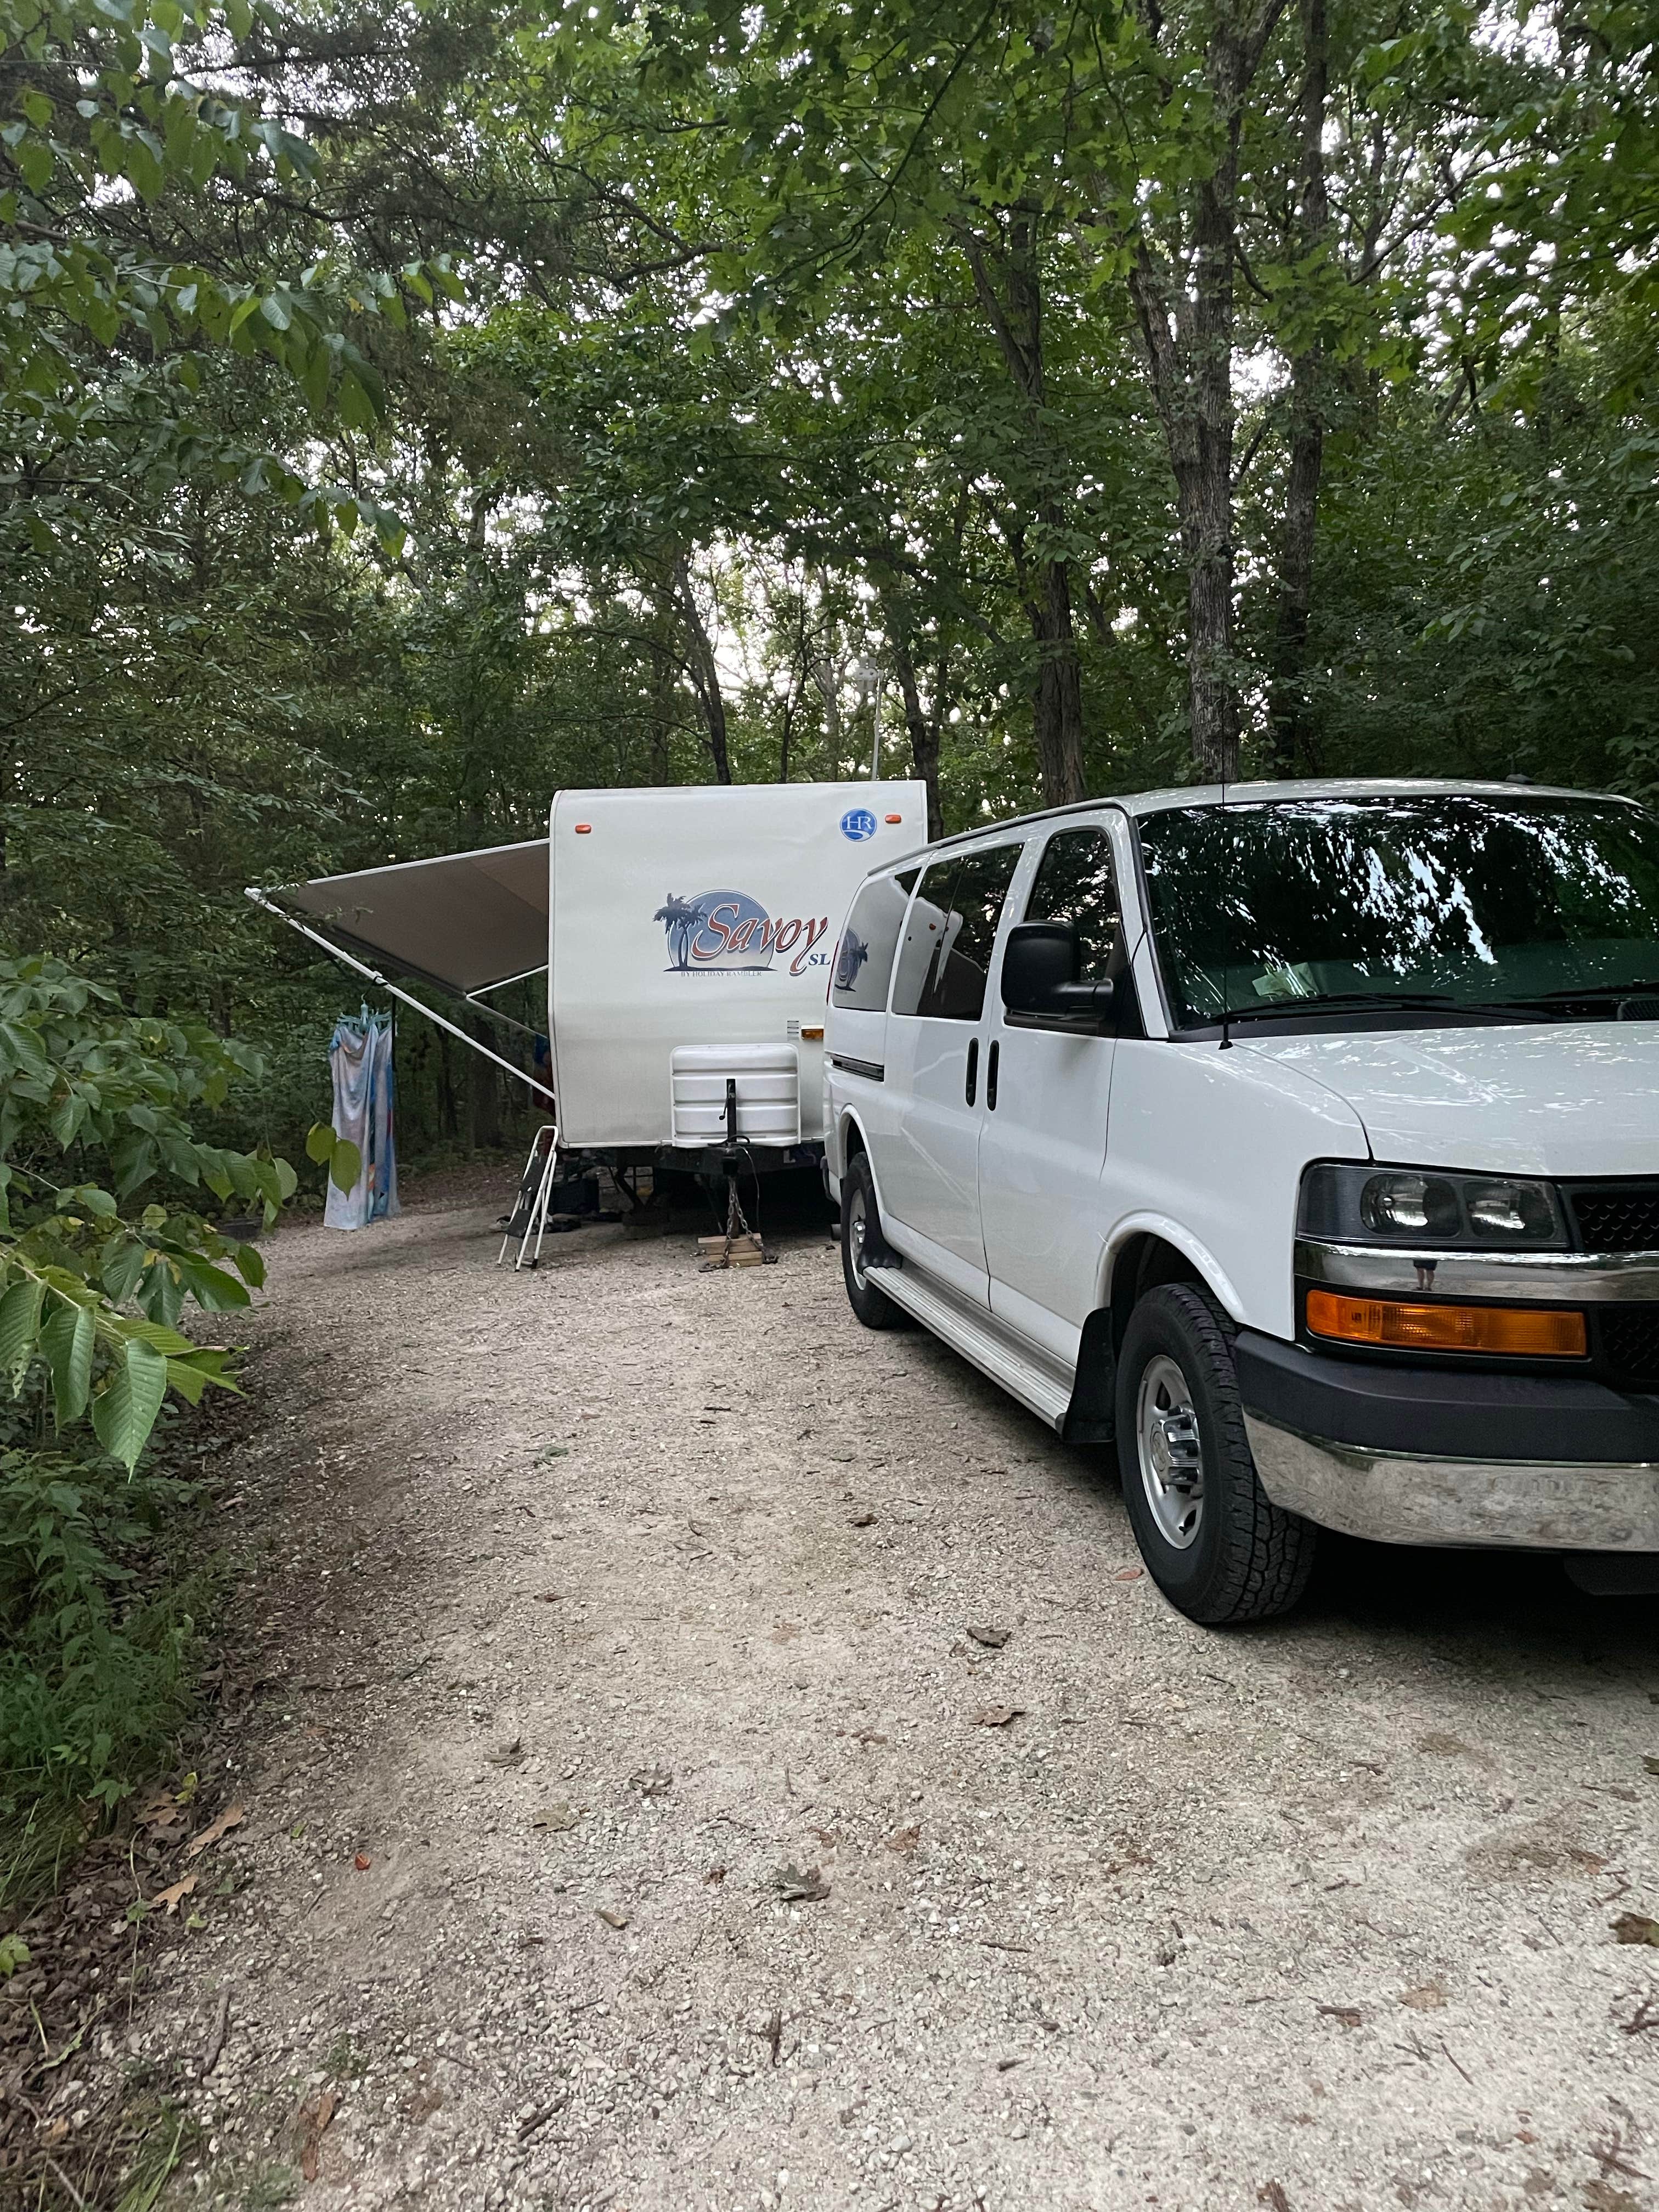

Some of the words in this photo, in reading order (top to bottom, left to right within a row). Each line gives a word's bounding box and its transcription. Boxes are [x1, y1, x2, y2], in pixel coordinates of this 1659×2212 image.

[847, 816, 872, 830] HR
[691, 904, 828, 976] Savoy
[809, 953, 831, 966] SL
